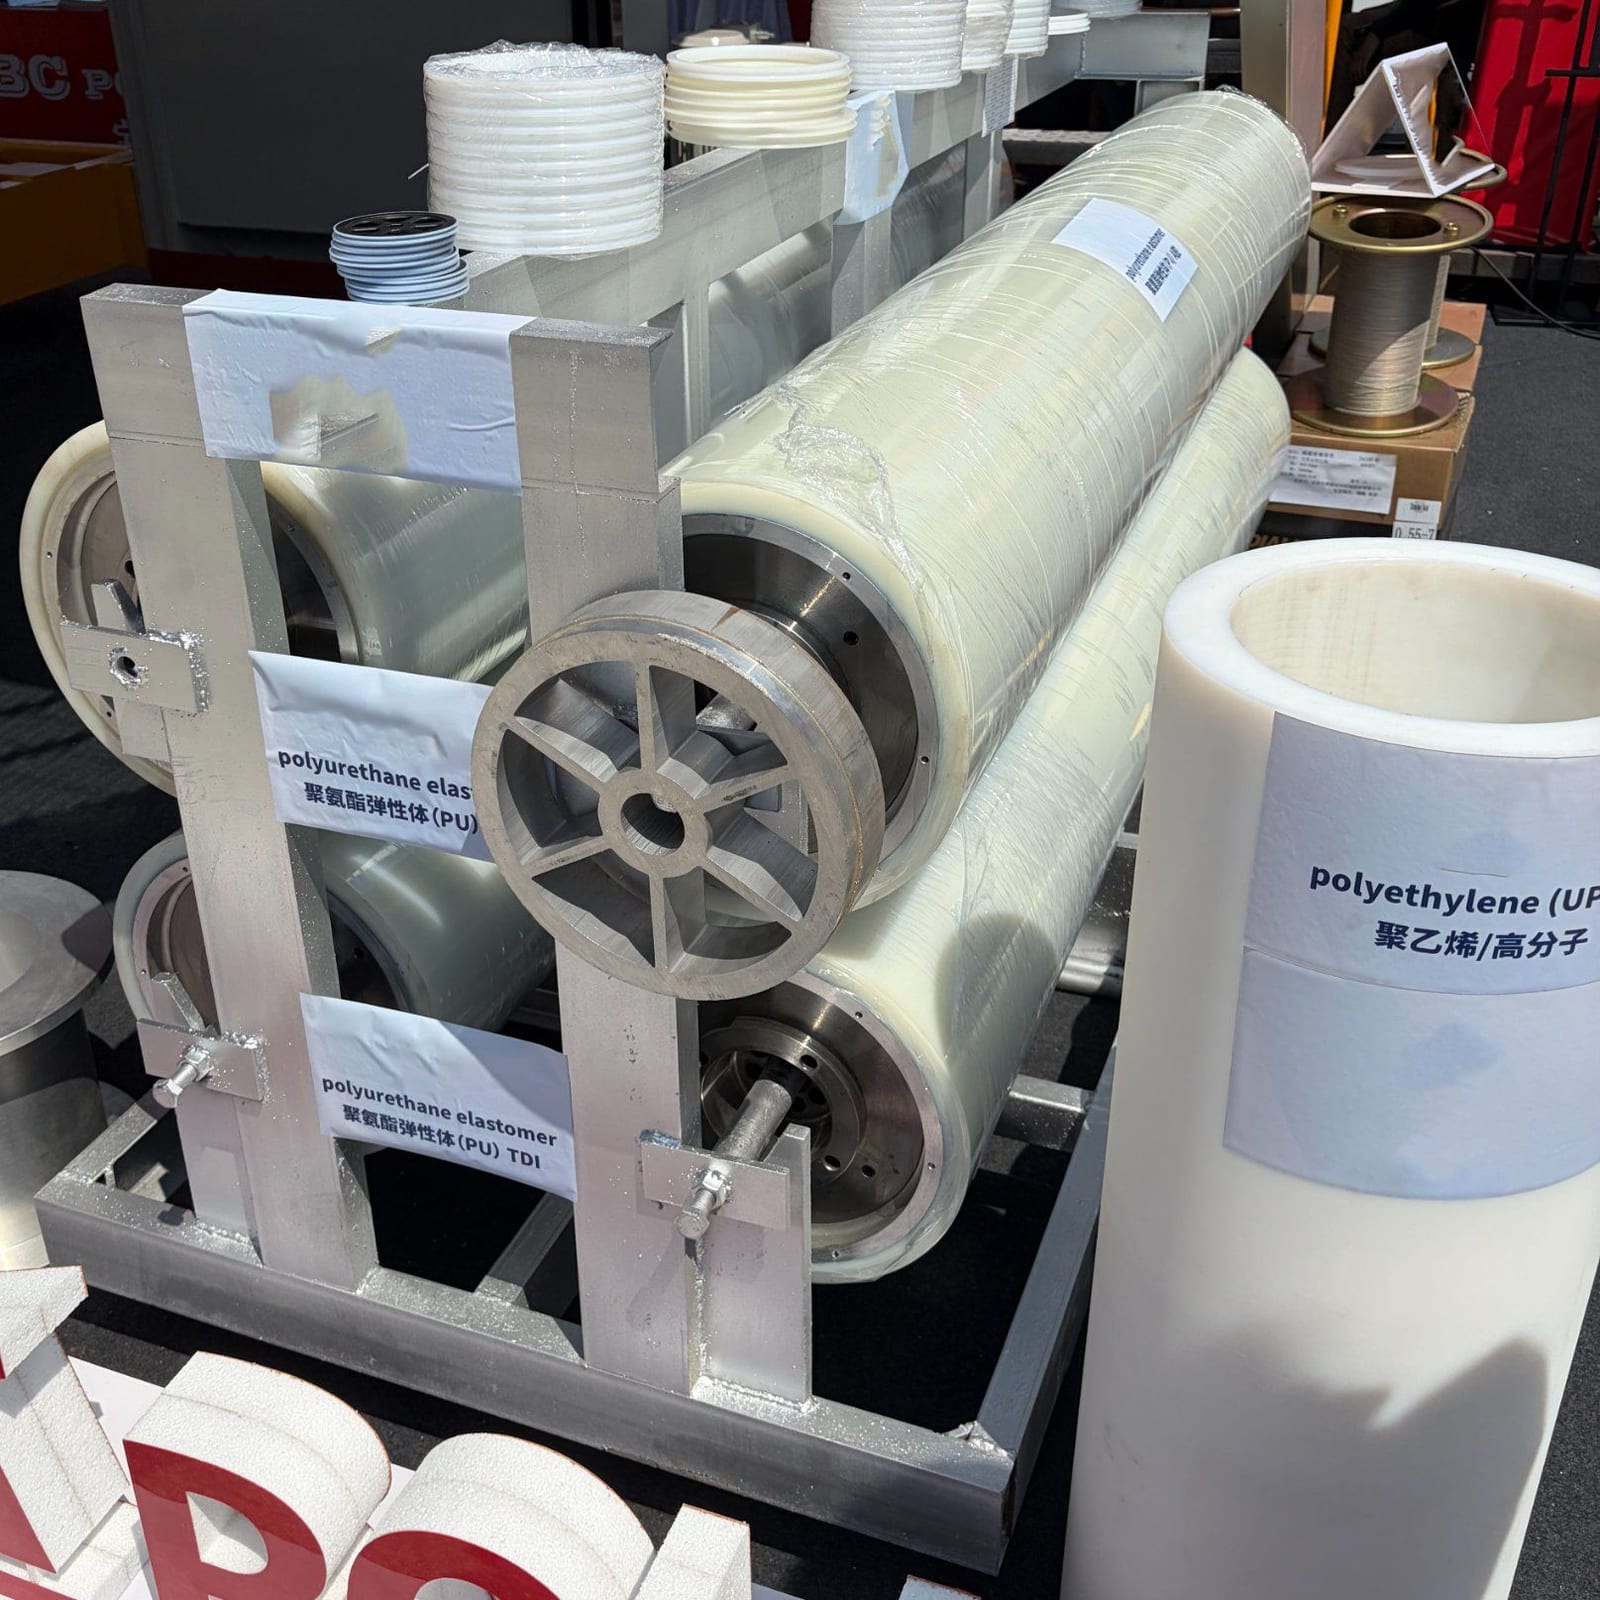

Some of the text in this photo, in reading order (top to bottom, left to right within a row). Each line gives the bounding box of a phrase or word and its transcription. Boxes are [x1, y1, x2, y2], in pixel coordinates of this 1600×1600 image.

[278, 750, 473, 800] polyurethane elas
[304, 781, 478, 834] 聚氨酯弹性体(PU)
[1309, 866, 1600, 918] polyethylene (UP
[1374, 920, 1588, 960] 聚乙烯/高分子
[322, 1077, 557, 1146] polyurethane elastomer
[343, 1104, 540, 1169] 聚氨酯弹性体(PU) TDI
